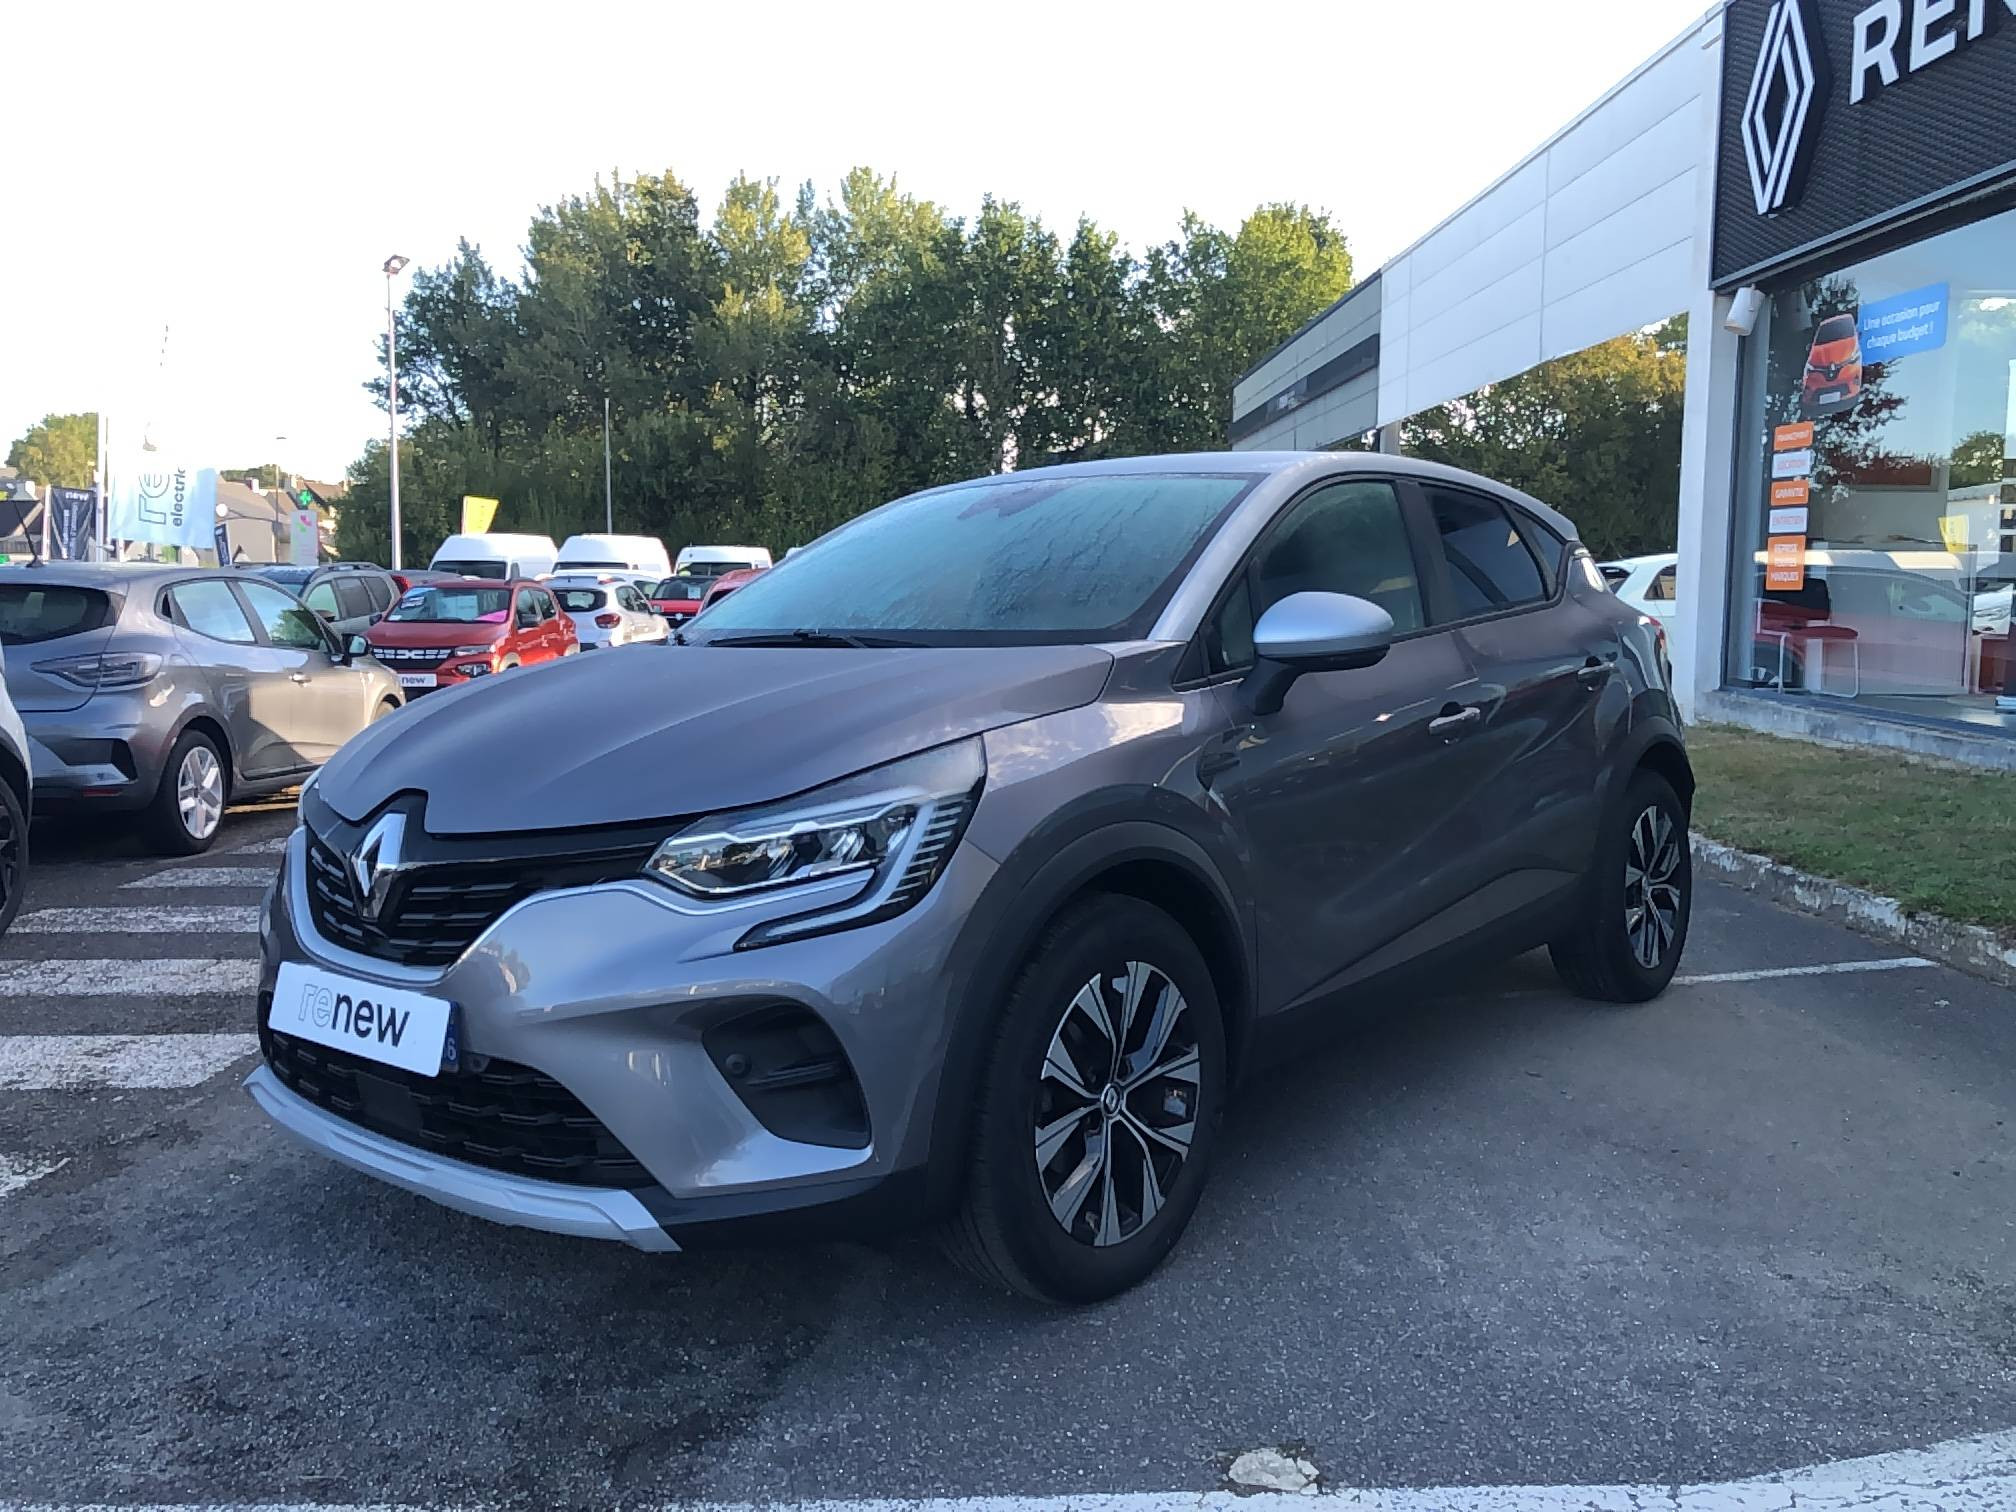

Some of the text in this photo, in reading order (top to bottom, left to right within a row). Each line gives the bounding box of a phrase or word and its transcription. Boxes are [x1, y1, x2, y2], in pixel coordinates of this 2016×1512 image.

[1863, 301, 1941, 331] Une occasion pour
[1866, 333, 1897, 349] chaque
[1897, 323, 1928, 342] budget
[298, 983, 411, 1048] renew
